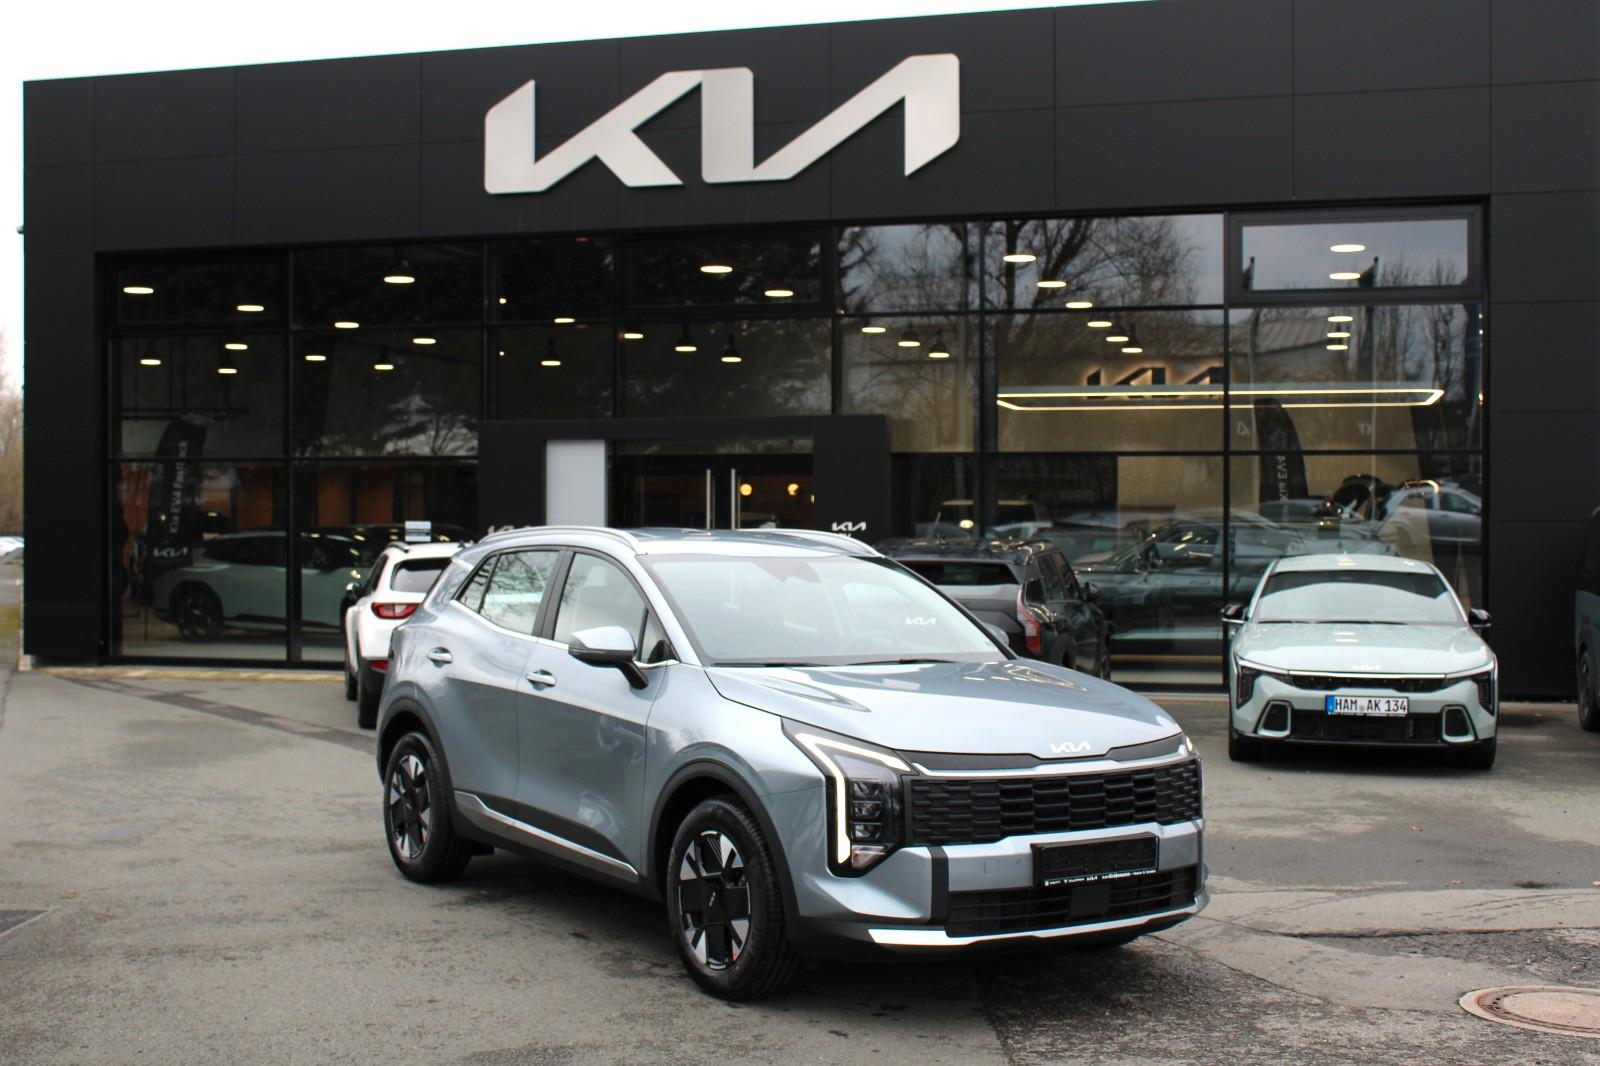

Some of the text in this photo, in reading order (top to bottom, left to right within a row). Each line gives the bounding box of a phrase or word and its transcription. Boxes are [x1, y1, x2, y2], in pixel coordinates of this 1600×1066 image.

[485, 53, 960, 194] KIA
[832, 521, 867, 531] KIA
[153, 546, 188, 557] KIA
[905, 616, 937, 625] KIA
[1335, 698, 1406, 712] HAM AK 134
[1049, 741, 1091, 753] KIA
